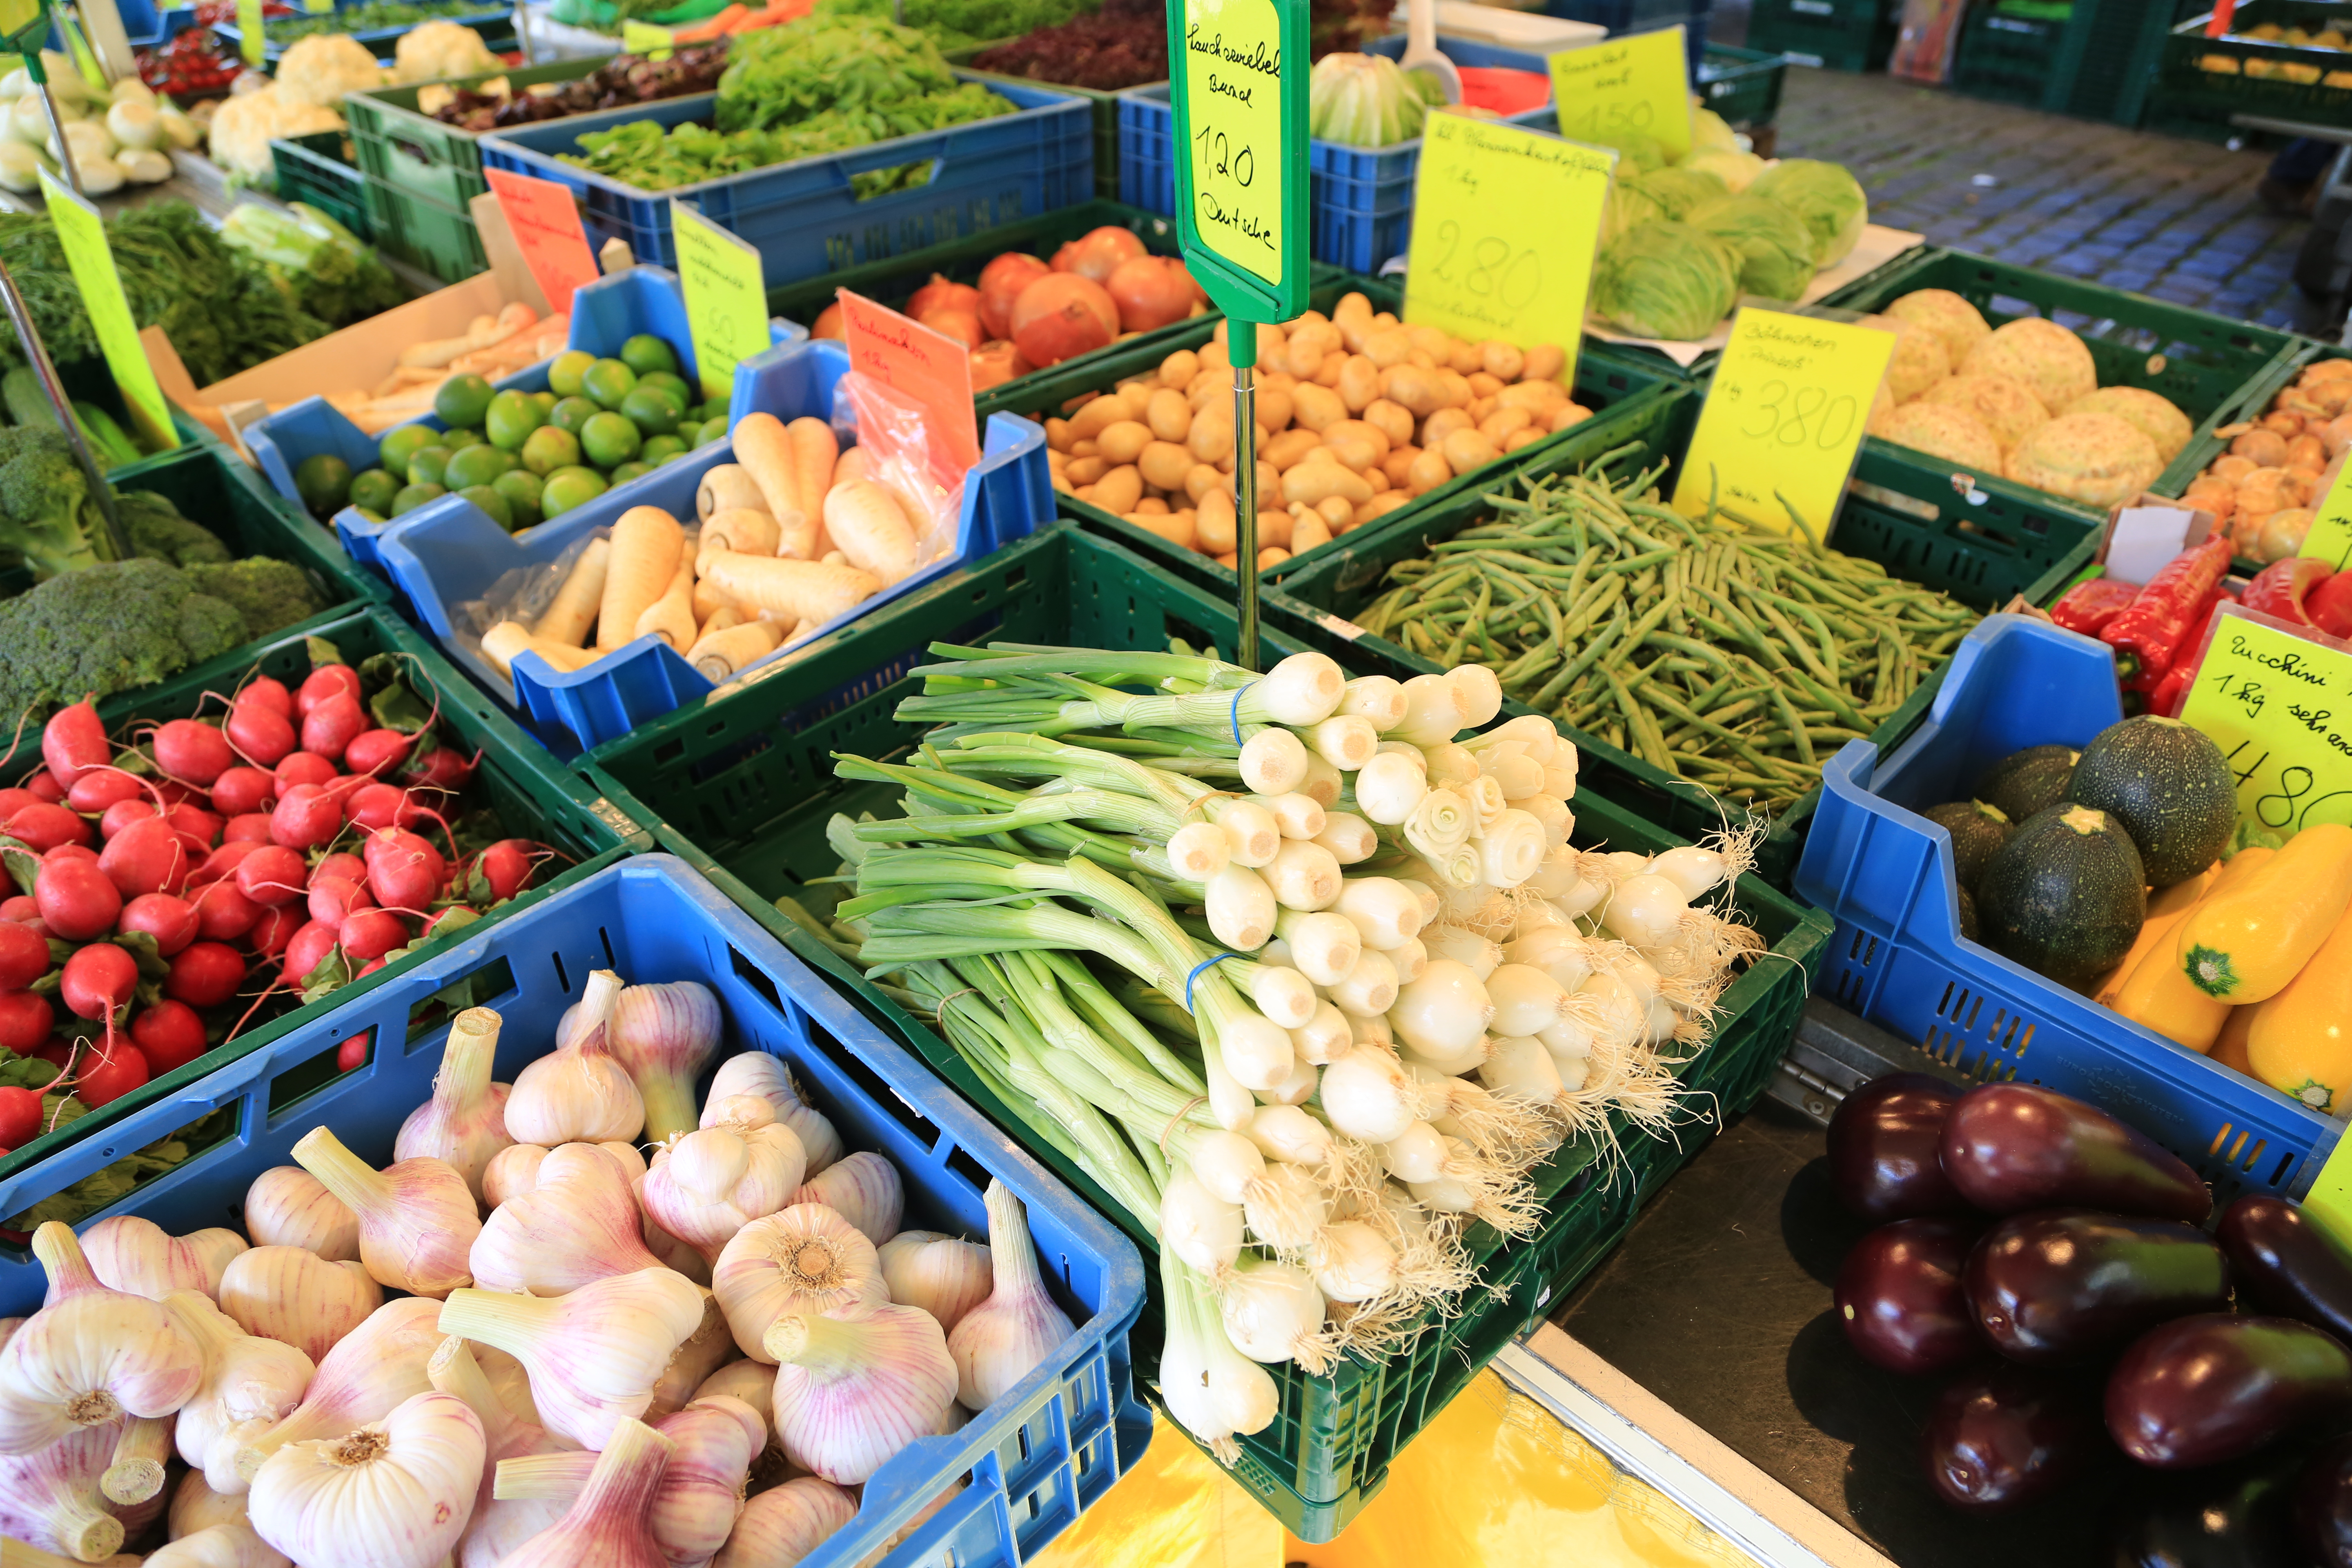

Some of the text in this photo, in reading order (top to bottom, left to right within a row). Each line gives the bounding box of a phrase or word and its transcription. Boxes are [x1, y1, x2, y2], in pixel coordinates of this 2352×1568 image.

[1209, 74, 1252, 109] Bund
[1200, 192, 1276, 250] Deutsche
[2232, 636, 2332, 686] Zucchini
[2213, 674, 2235, 693] 1
[2232, 683, 2265, 718] kg
[2287, 704, 2331, 733] sehr
[2056, 1056, 2185, 1125] EURO POOL SYSTEM
